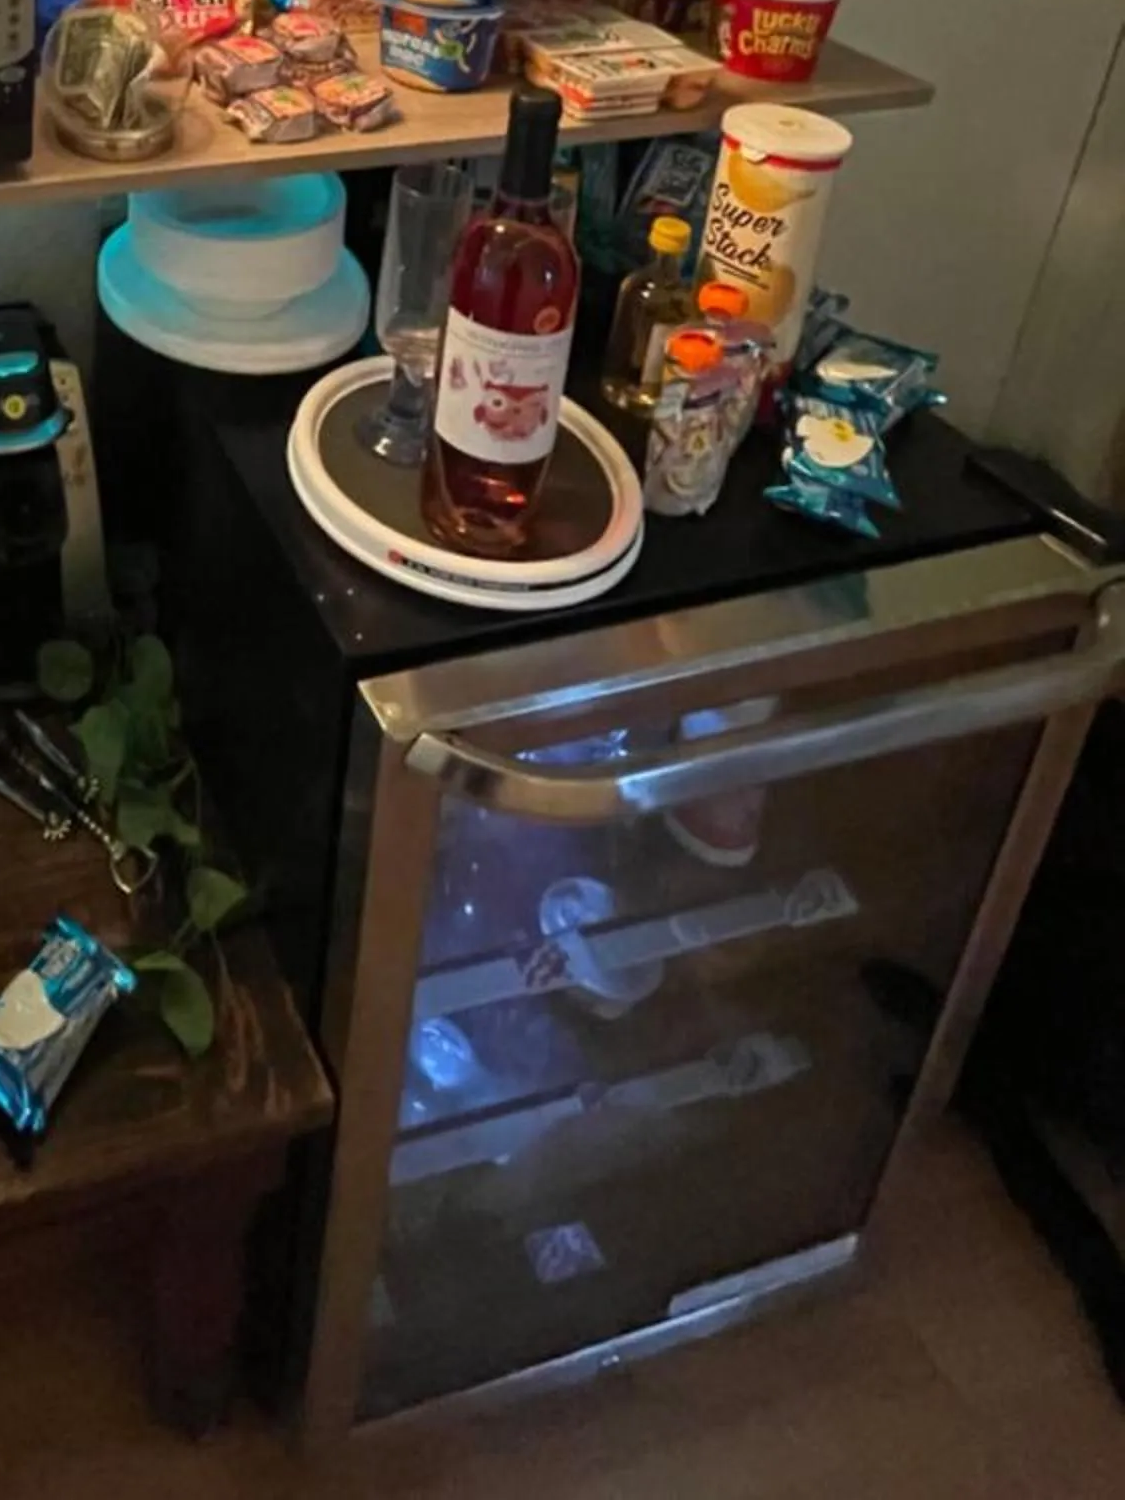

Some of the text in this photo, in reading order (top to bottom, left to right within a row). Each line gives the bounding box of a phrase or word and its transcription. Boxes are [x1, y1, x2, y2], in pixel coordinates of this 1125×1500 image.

[752, 7, 821, 36] Lucky
[738, 29, 816, 60] Charms
[712, 182, 786, 237] Super
[706, 217, 773, 272] Stack
